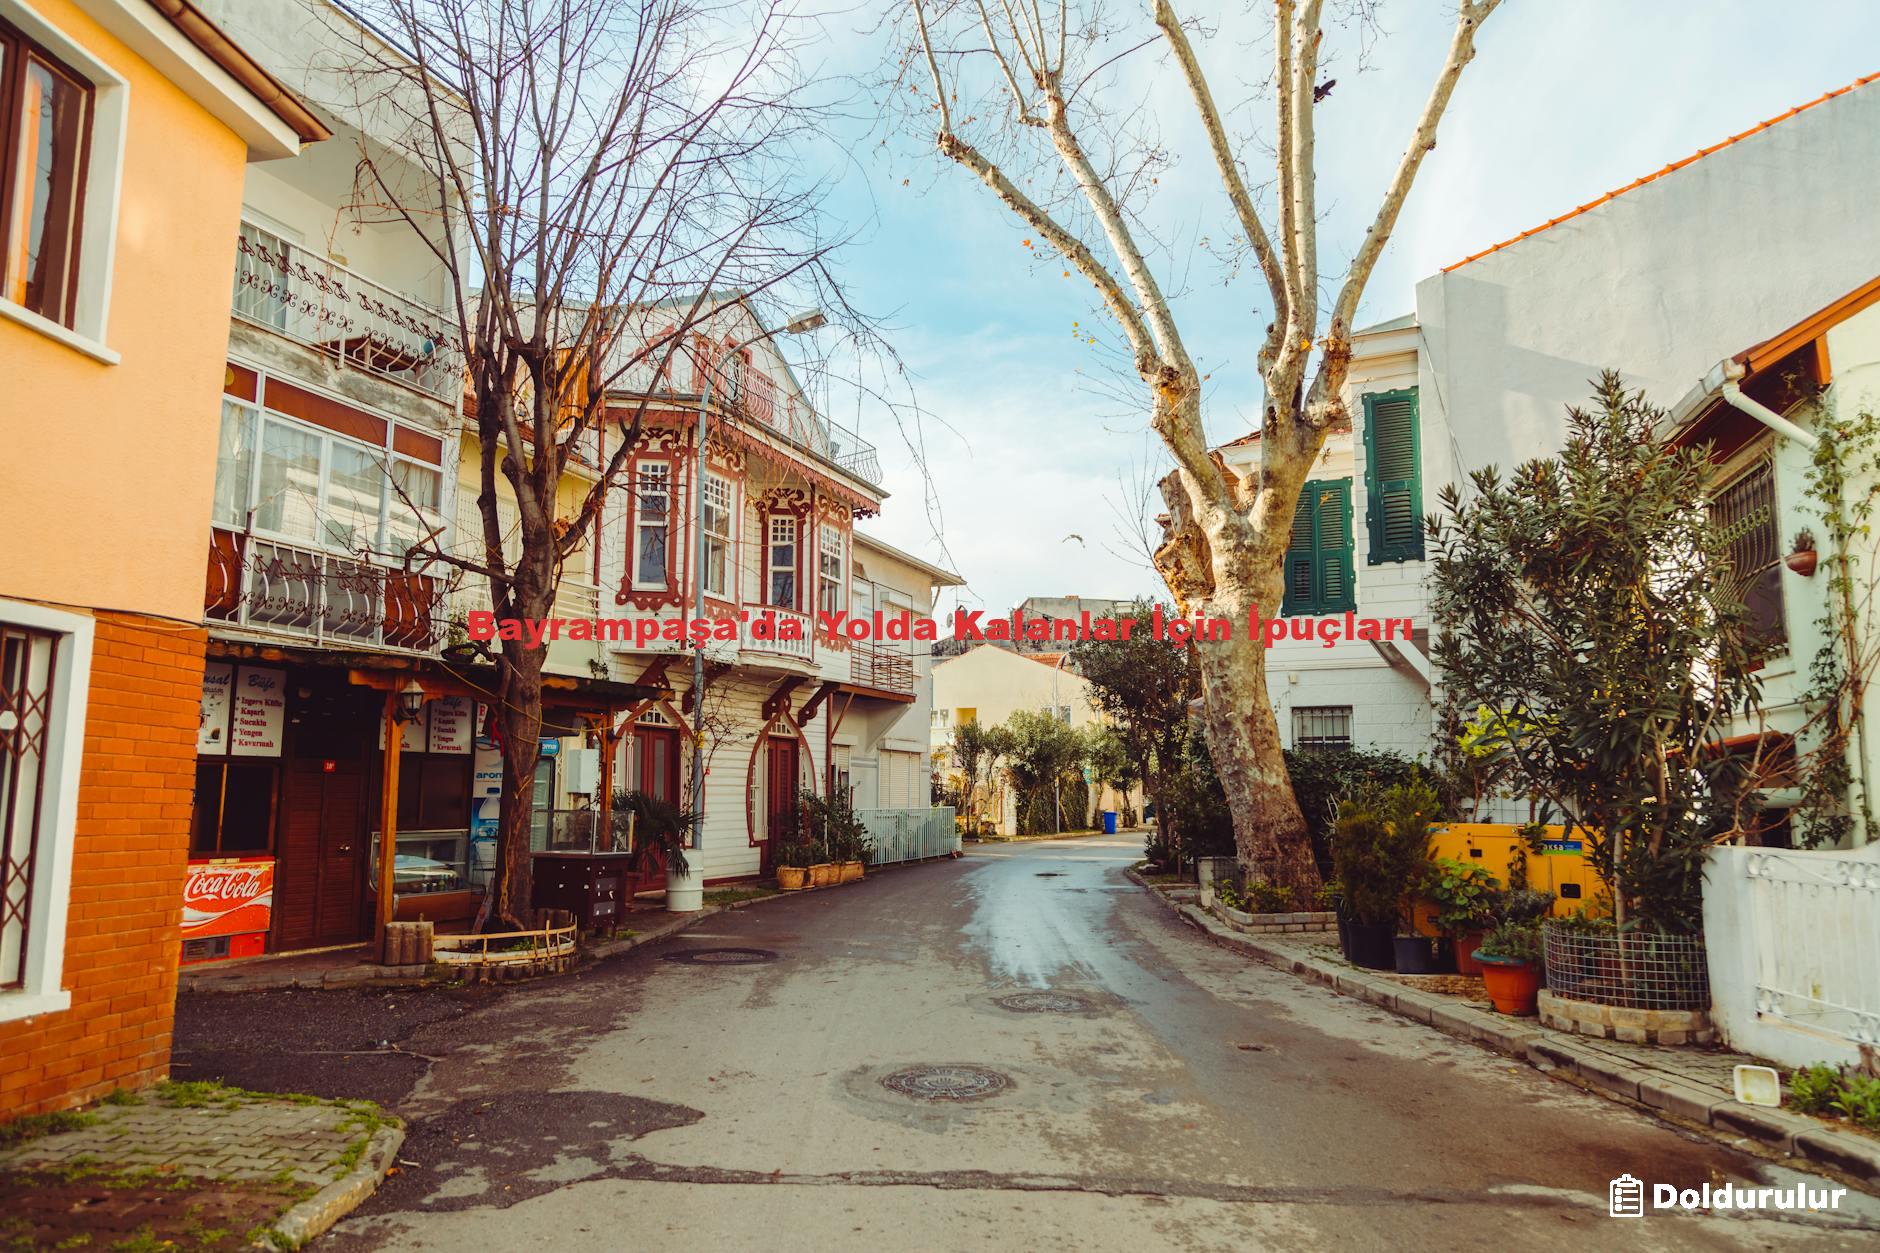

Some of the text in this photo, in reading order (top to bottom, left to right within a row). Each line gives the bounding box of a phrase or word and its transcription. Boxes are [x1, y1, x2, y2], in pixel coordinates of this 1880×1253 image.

[248, 674, 276, 692] Büfe
[240, 707, 265, 717] Kaşarlı
[239, 728, 263, 738] Yengen
[238, 739, 274, 748] Kavurmalı
